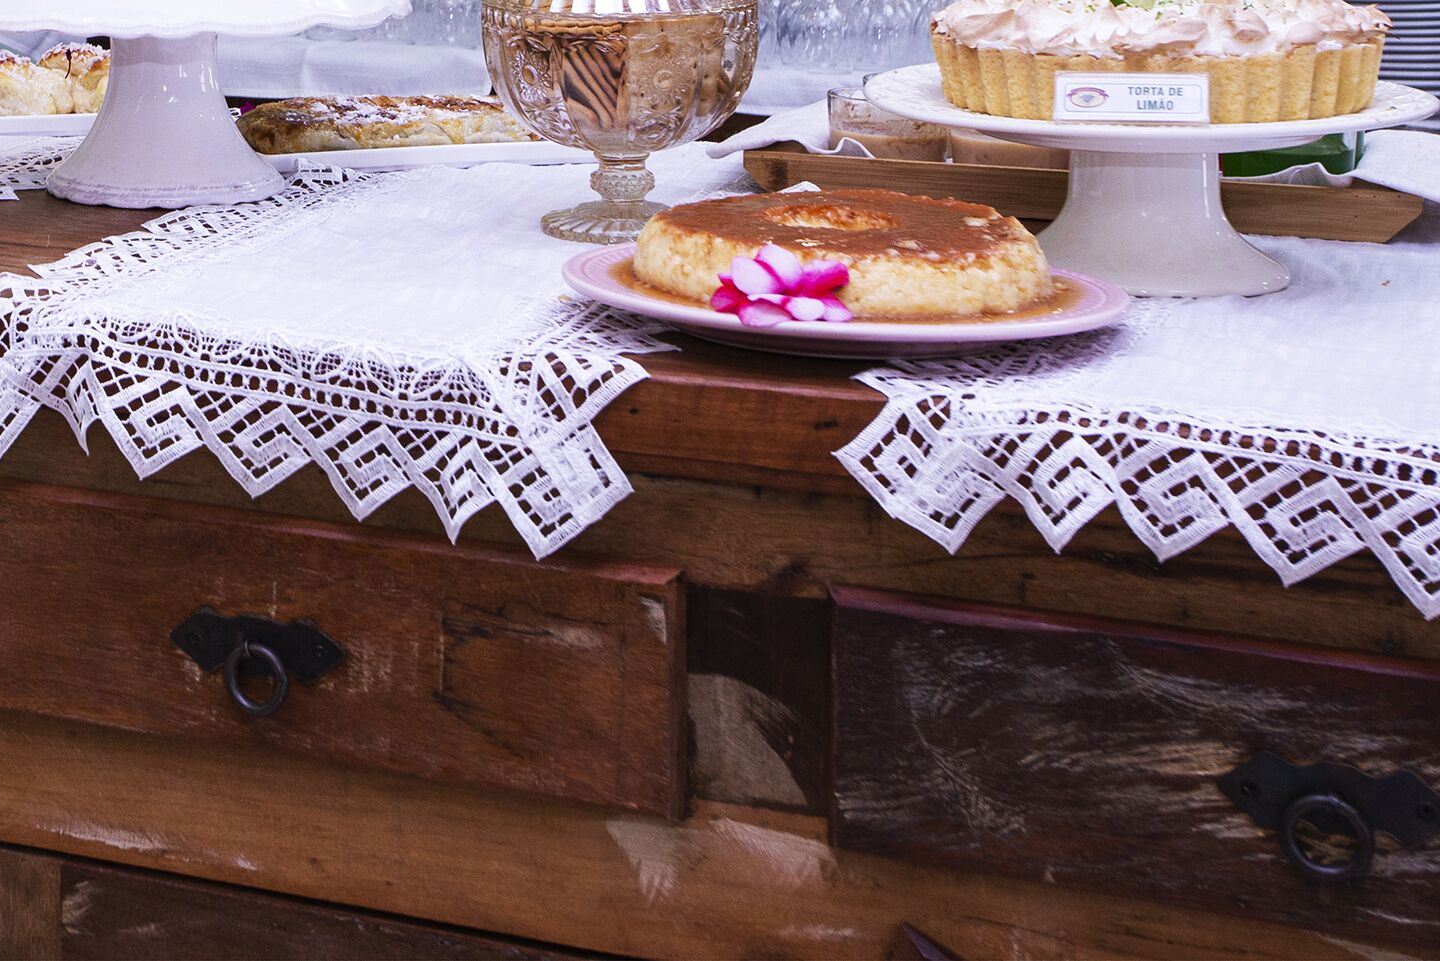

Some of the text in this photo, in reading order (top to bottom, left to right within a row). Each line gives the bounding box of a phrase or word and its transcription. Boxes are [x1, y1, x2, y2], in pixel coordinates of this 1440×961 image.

[1127, 86, 1184, 97] TORTA DE
[1136, 97, 1175, 111] LIMÃO
